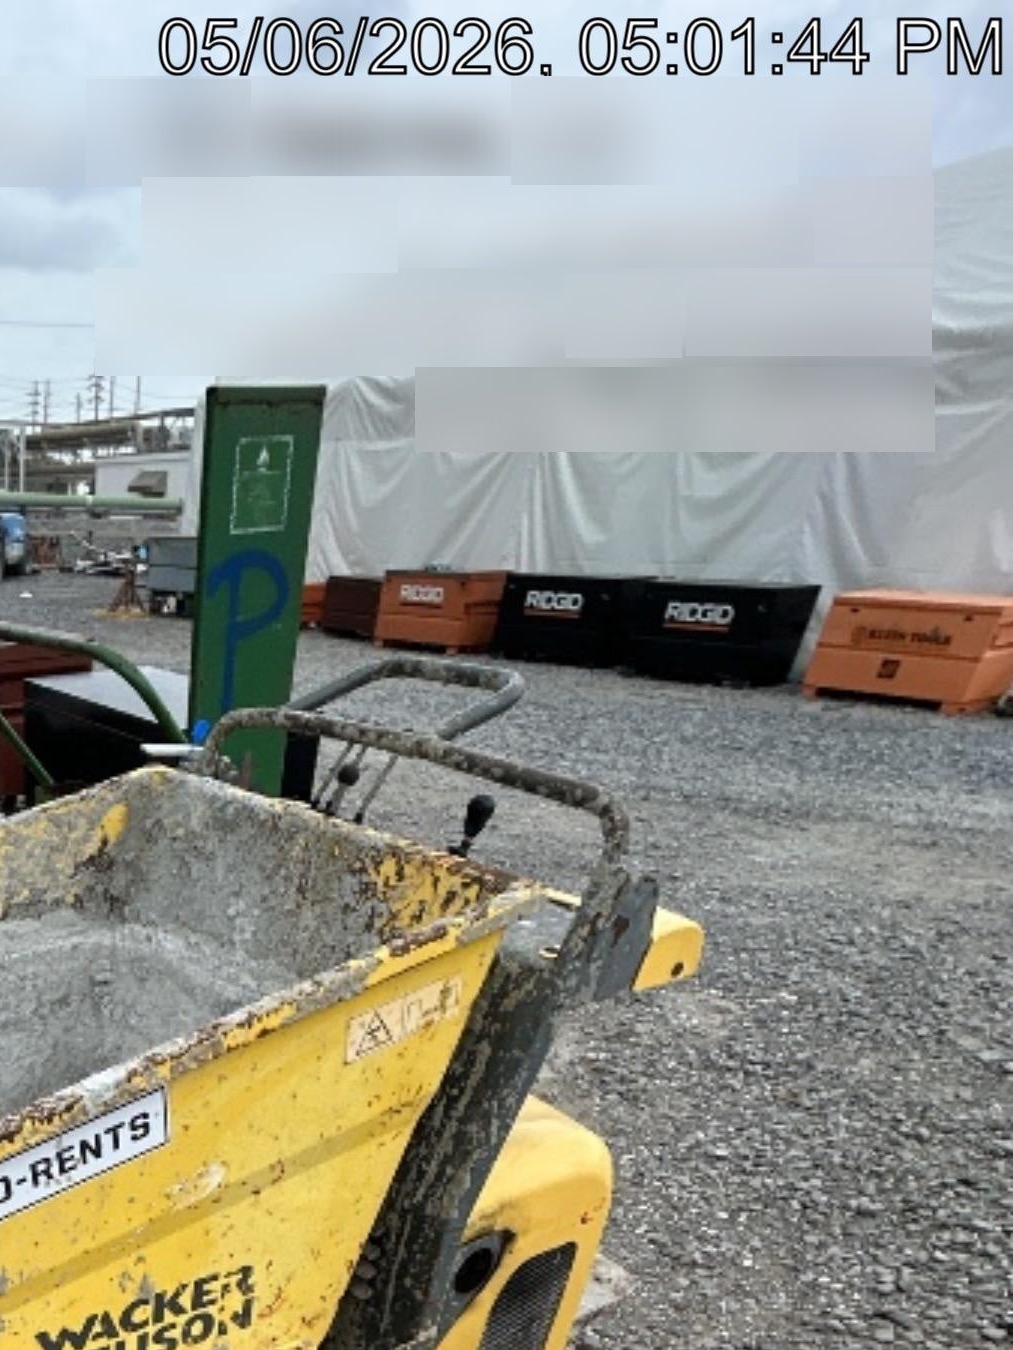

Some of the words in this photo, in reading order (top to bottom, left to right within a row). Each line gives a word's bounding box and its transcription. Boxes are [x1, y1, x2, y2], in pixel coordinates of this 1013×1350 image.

[399, 584, 445, 602] RIDGID
[524, 589, 585, 612] RIDGID
[663, 601, 736, 625] RIDGID
